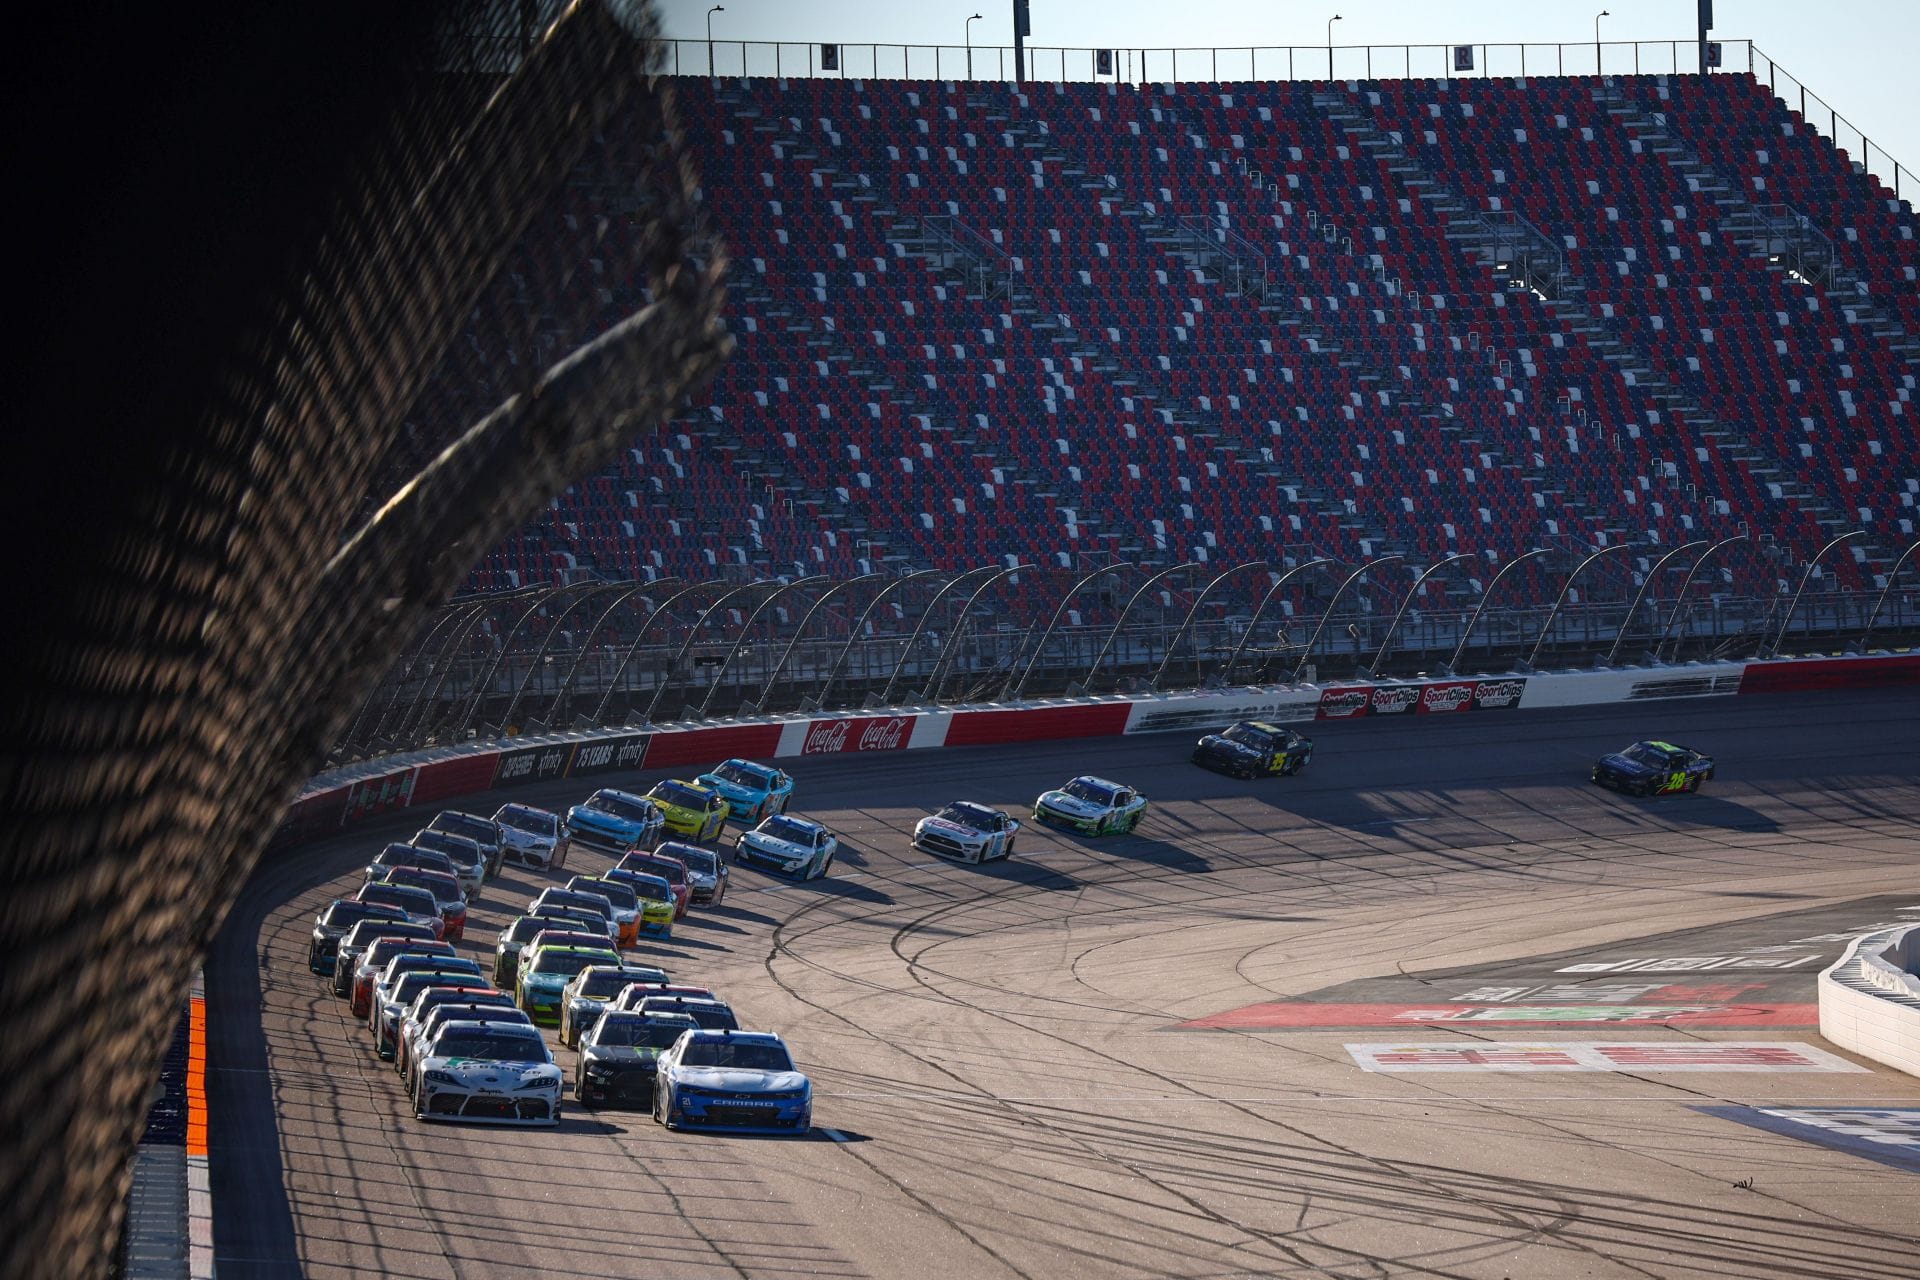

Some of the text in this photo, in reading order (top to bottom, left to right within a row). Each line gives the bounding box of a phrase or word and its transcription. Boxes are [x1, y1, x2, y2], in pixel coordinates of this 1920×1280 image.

[1459, 47, 1469, 65] R
[1708, 43, 1716, 61] S
[587, 744, 614, 767] YEARS
[1668, 771, 1687, 790] 28
[682, 1097, 692, 1107] 21
[712, 1099, 775, 1108] CAMARO
